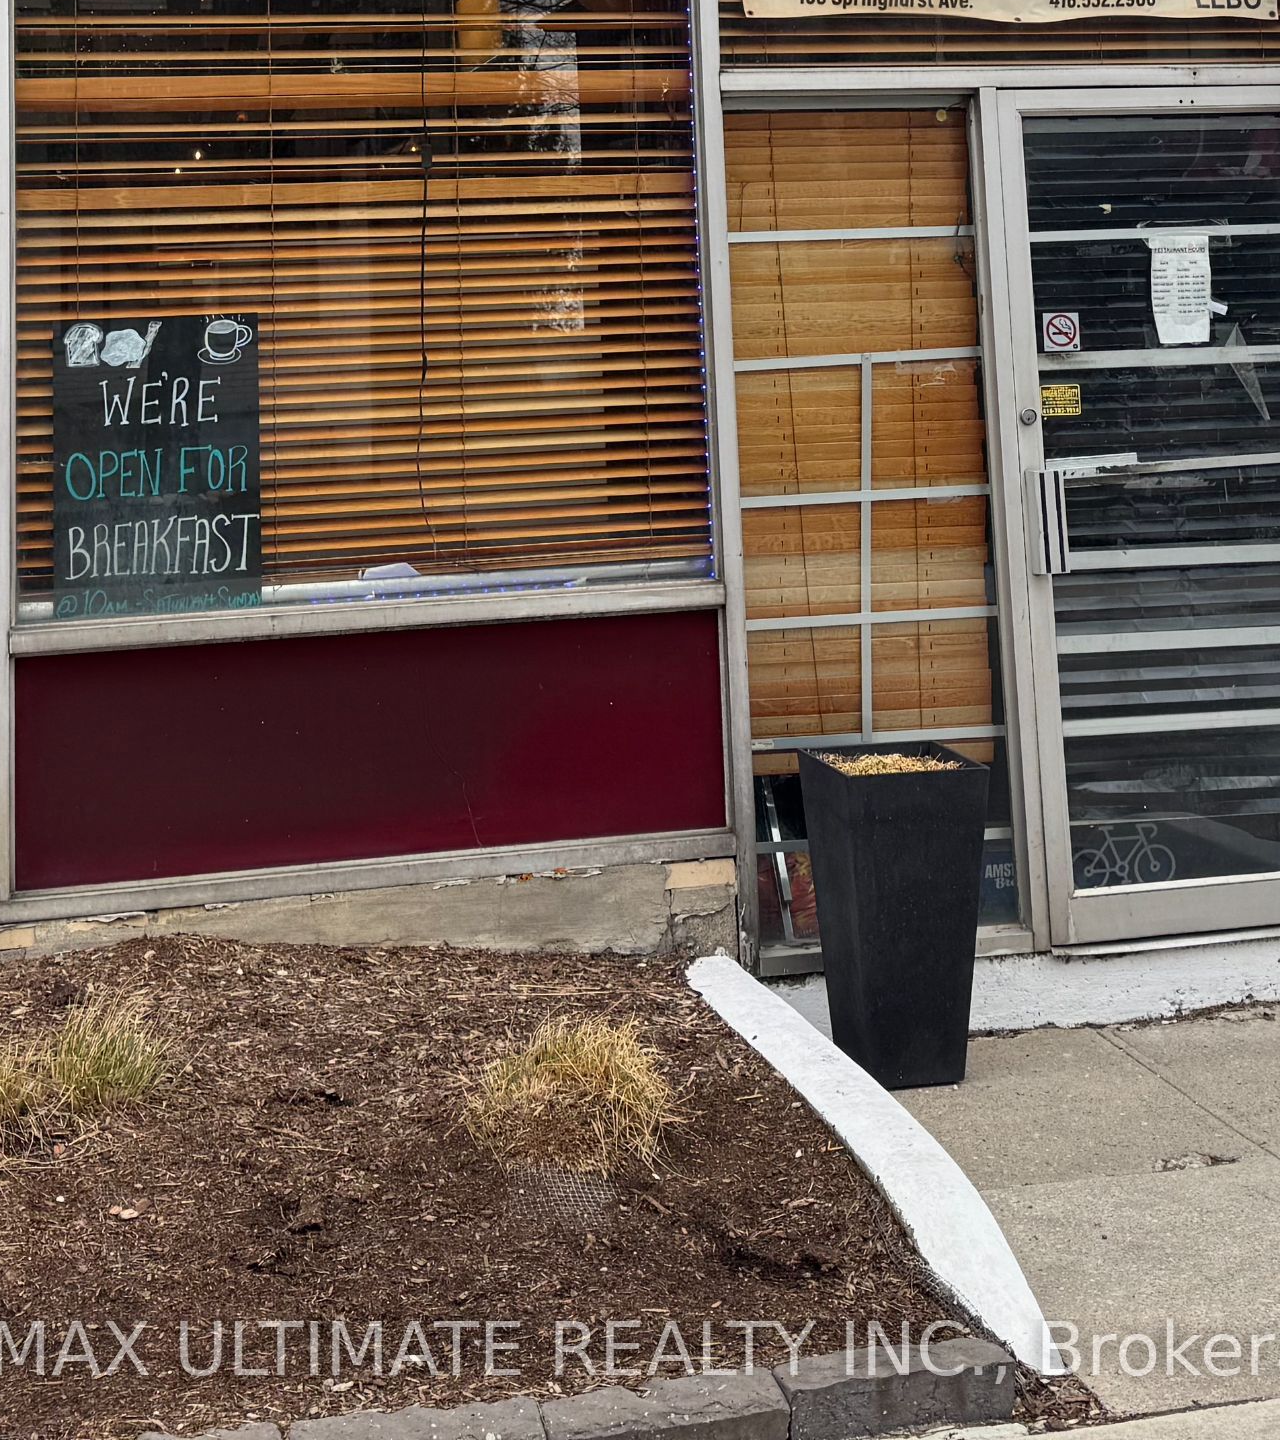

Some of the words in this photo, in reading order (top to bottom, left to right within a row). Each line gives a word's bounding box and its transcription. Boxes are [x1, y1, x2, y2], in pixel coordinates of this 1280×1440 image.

[100, 372, 220, 427] WE'RE
[65, 448, 161, 500] OPEN
[178, 444, 248, 493] FOR
[65, 514, 259, 580] BREAKFAST
